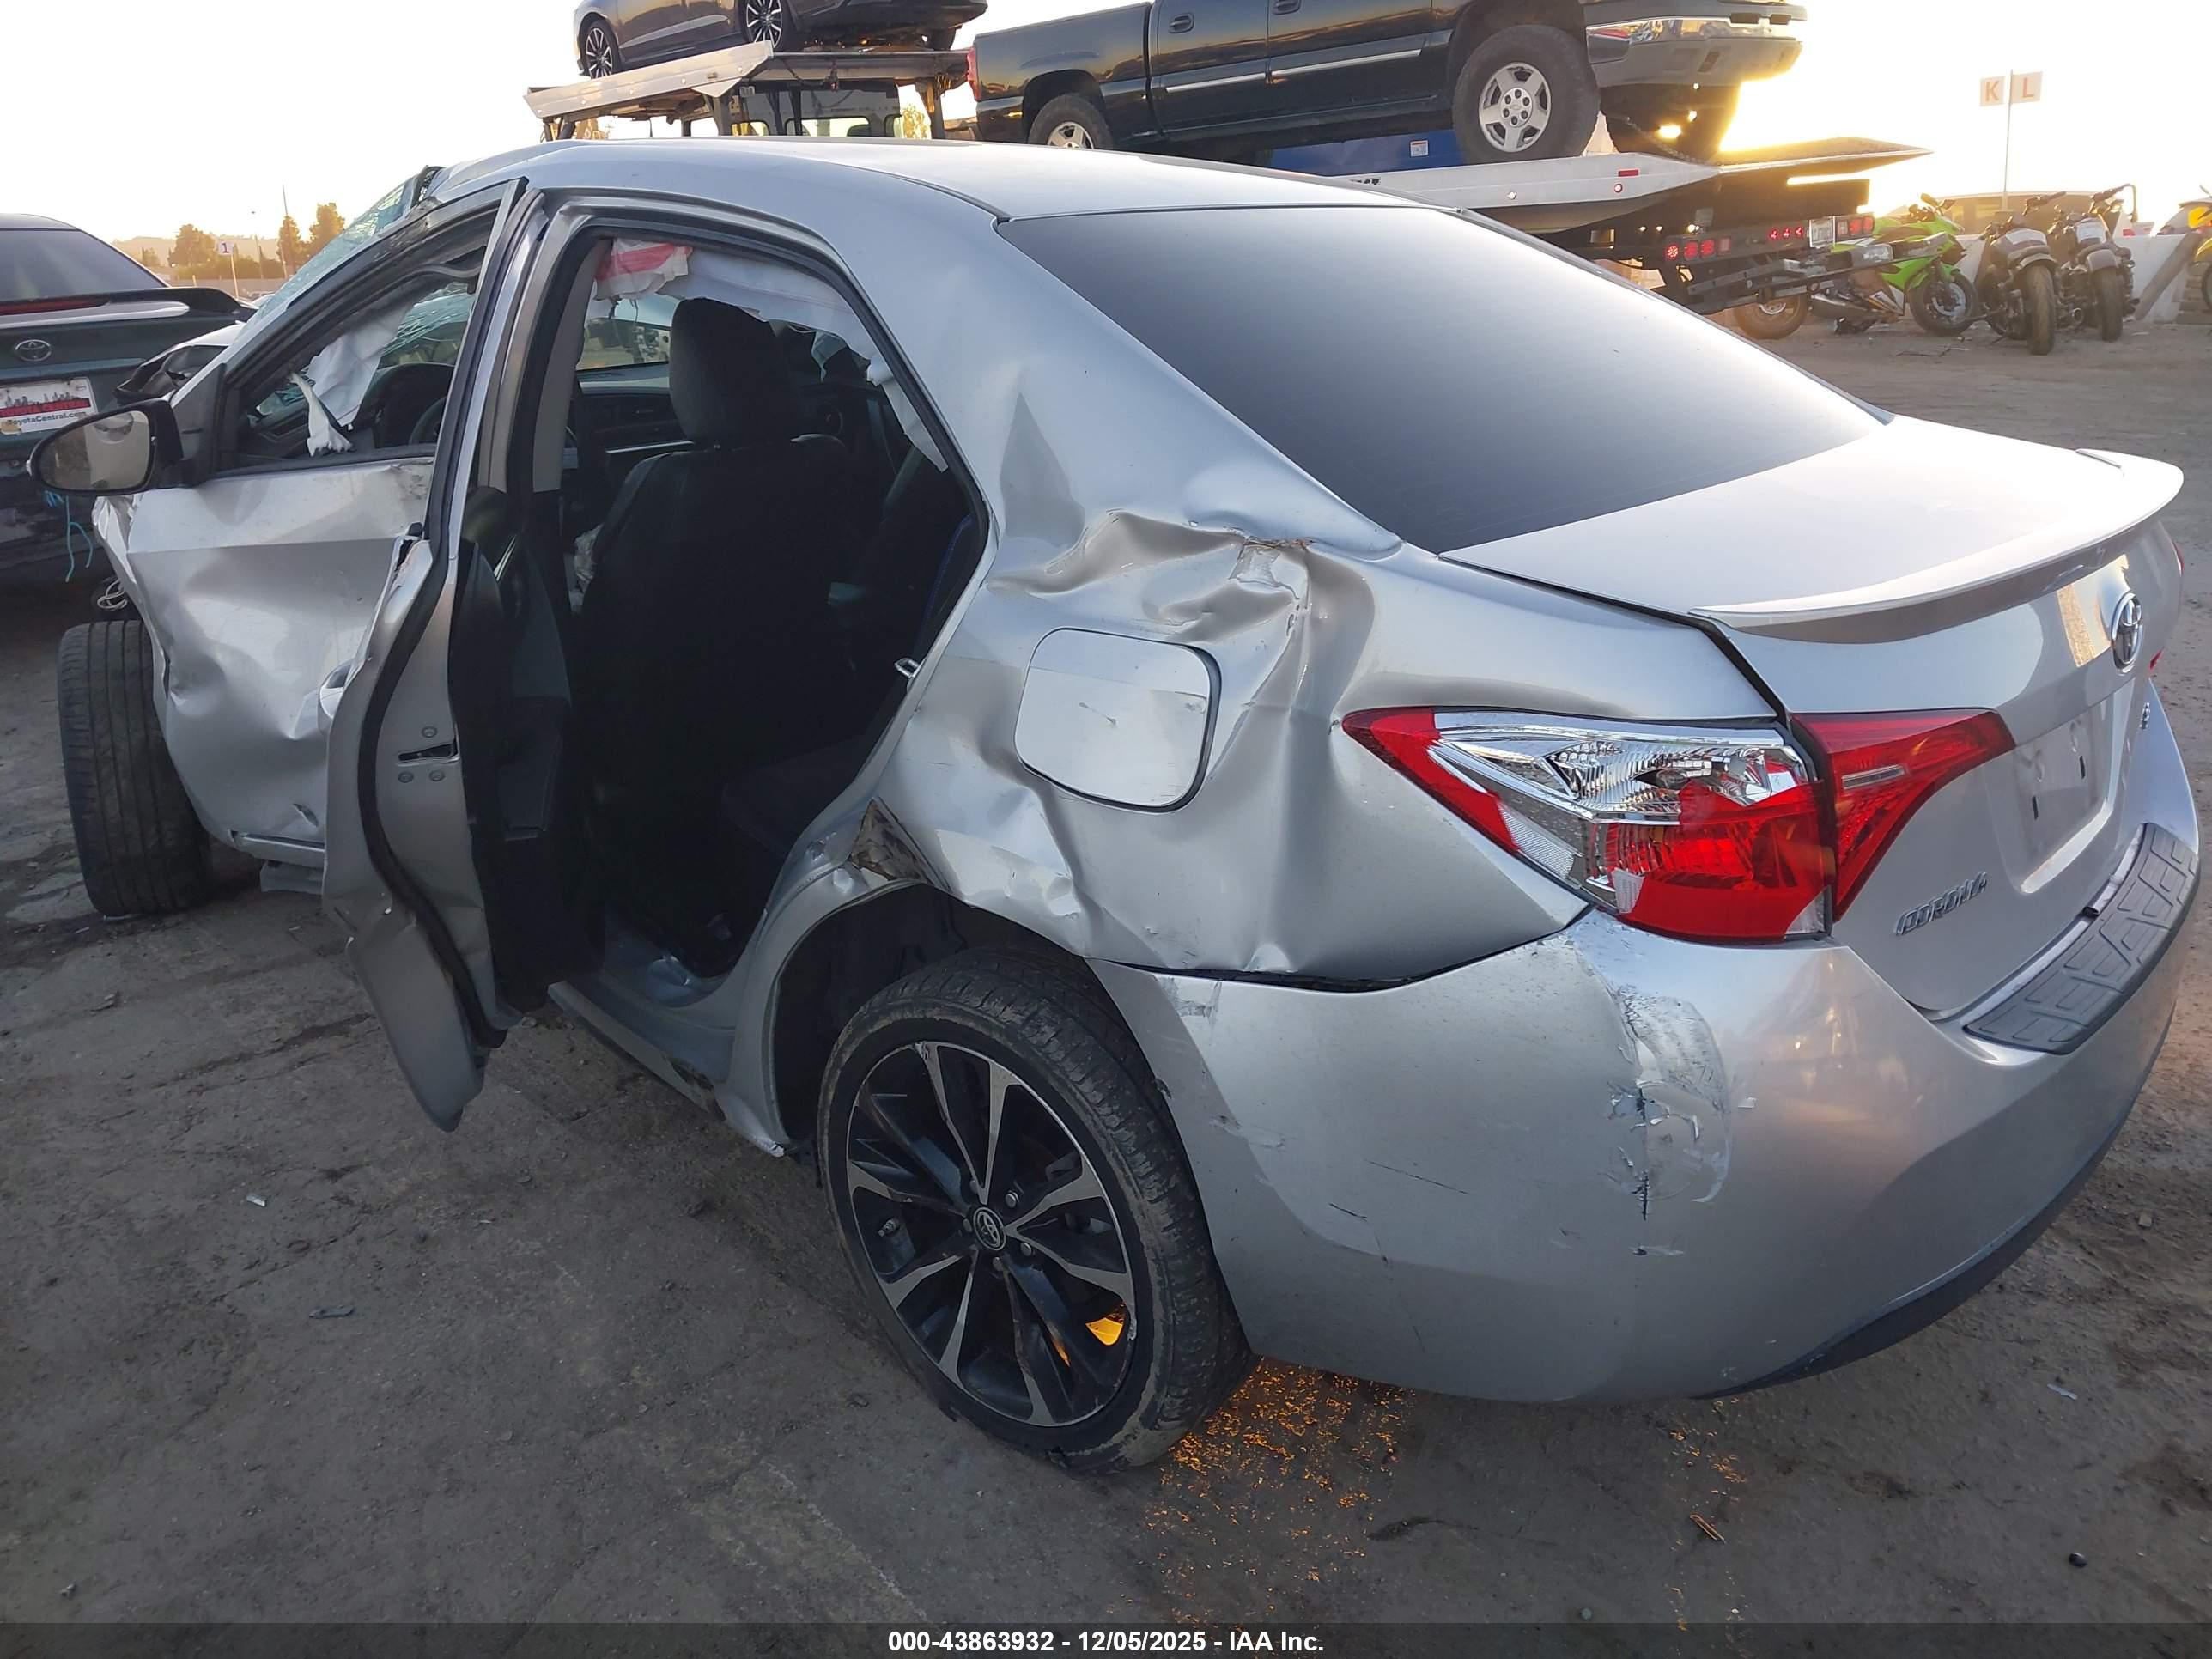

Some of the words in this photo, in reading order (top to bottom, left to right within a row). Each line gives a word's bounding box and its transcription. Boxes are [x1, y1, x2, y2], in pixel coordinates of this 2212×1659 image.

[1985, 81, 2000, 102] K
[2022, 76, 2035, 98] L
[222, 242, 229, 254] 1
[1894, 871, 1987, 936] COROLLA
